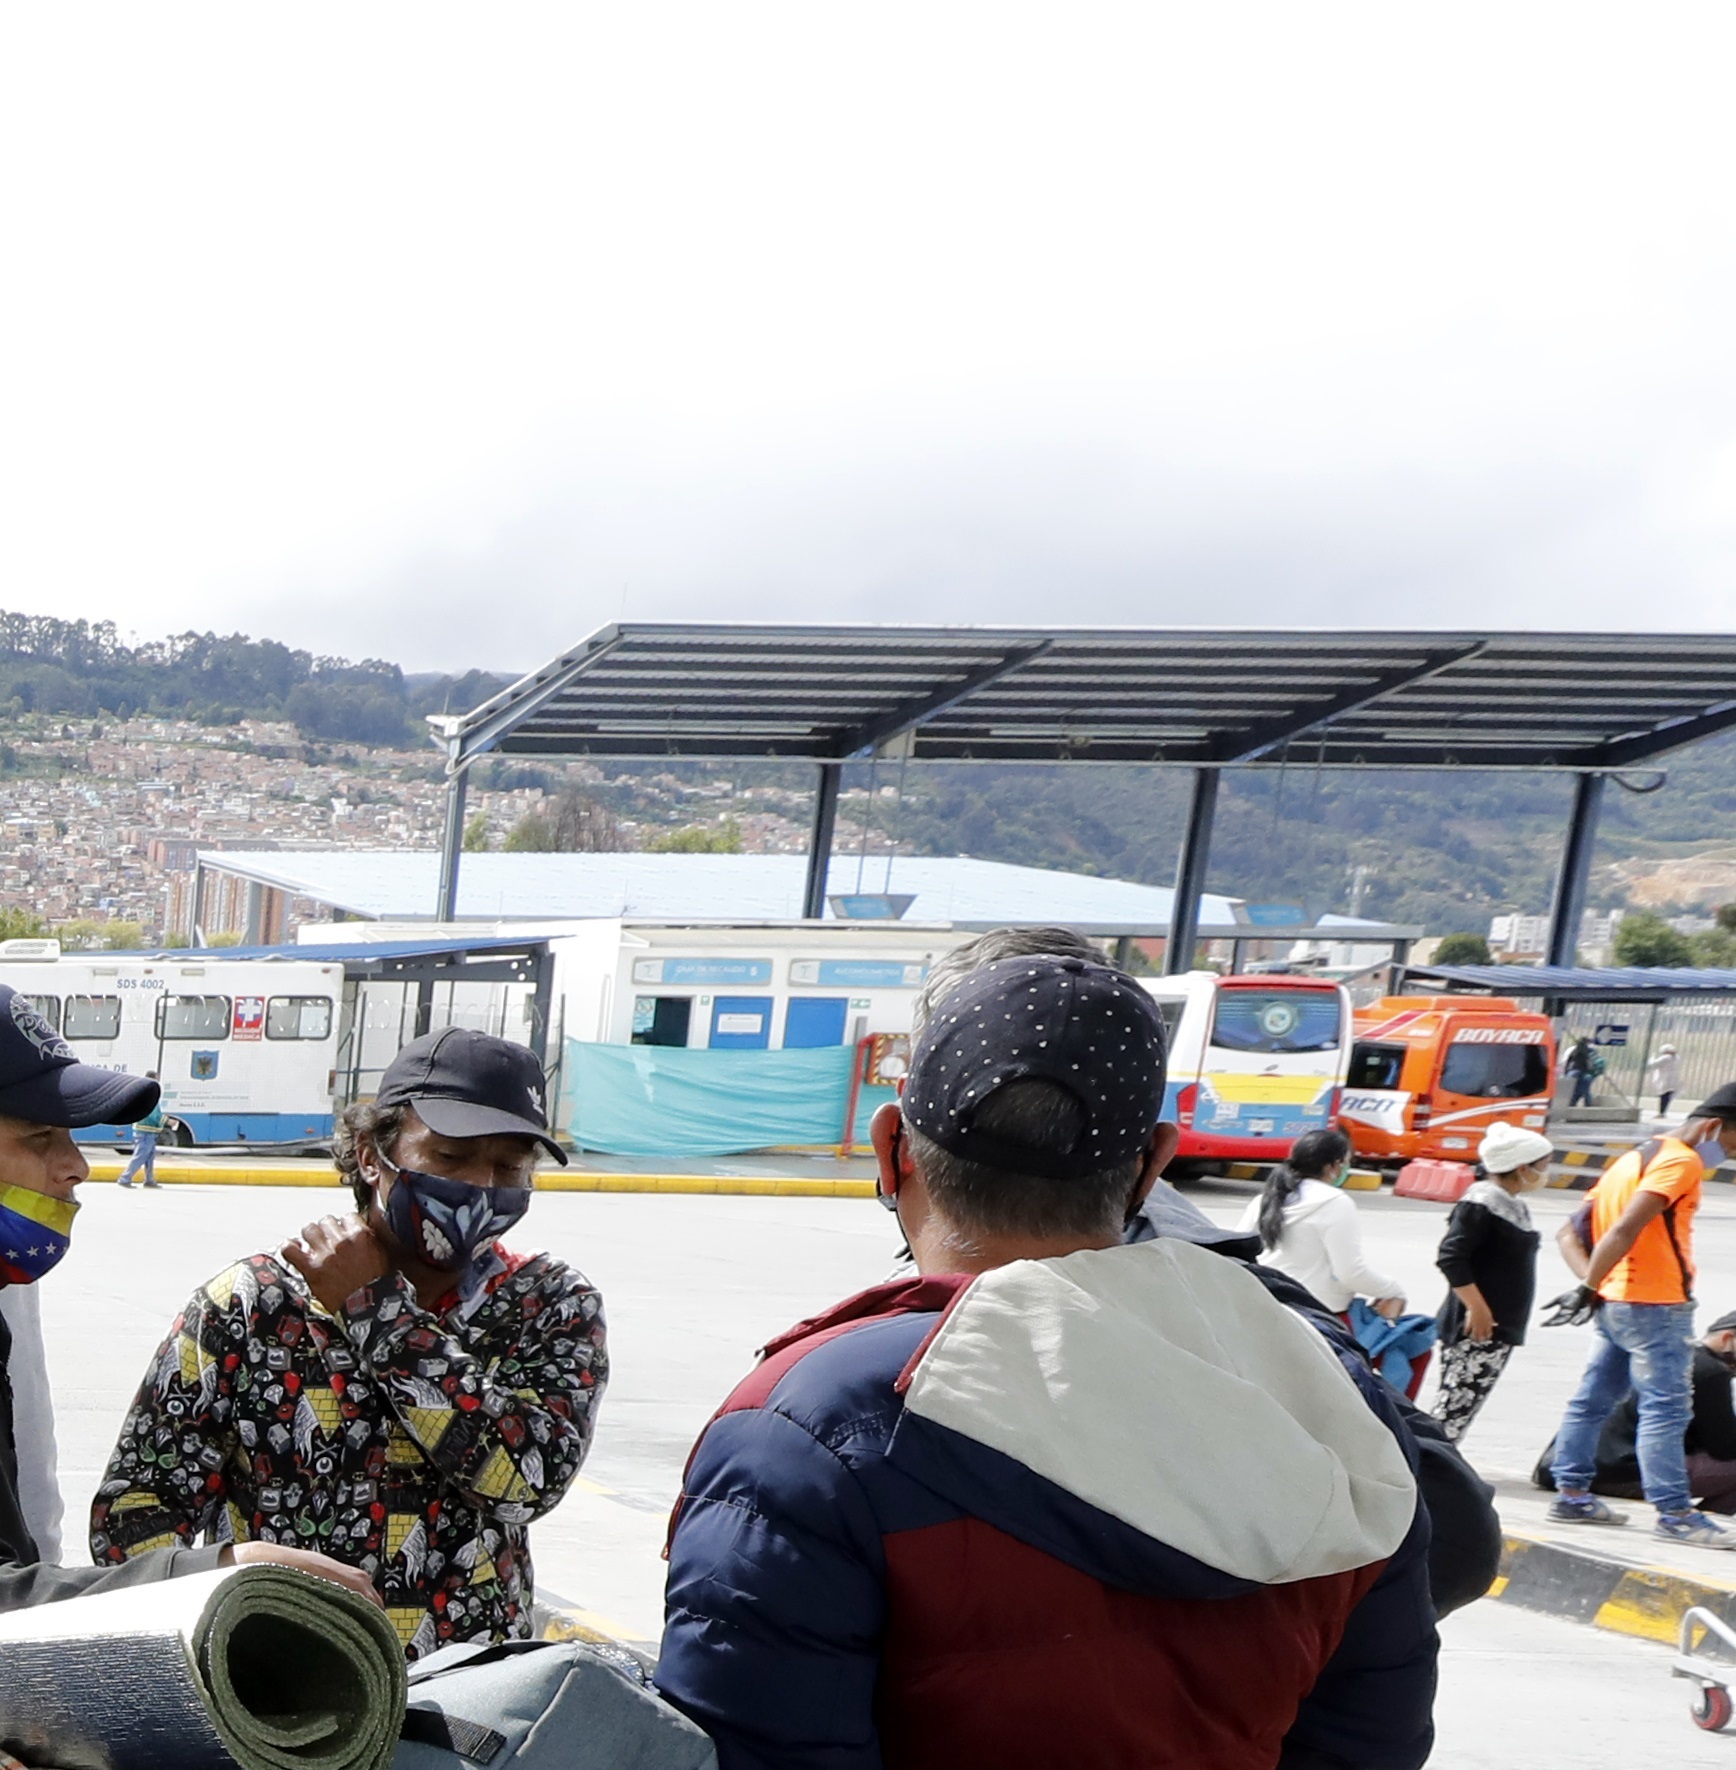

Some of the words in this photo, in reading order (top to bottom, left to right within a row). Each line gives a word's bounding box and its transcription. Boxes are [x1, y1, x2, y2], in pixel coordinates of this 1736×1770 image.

[116, 979, 137, 989] SDS
[140, 979, 165, 990] 4002
[1454, 1027, 1544, 1044] BOYACA
